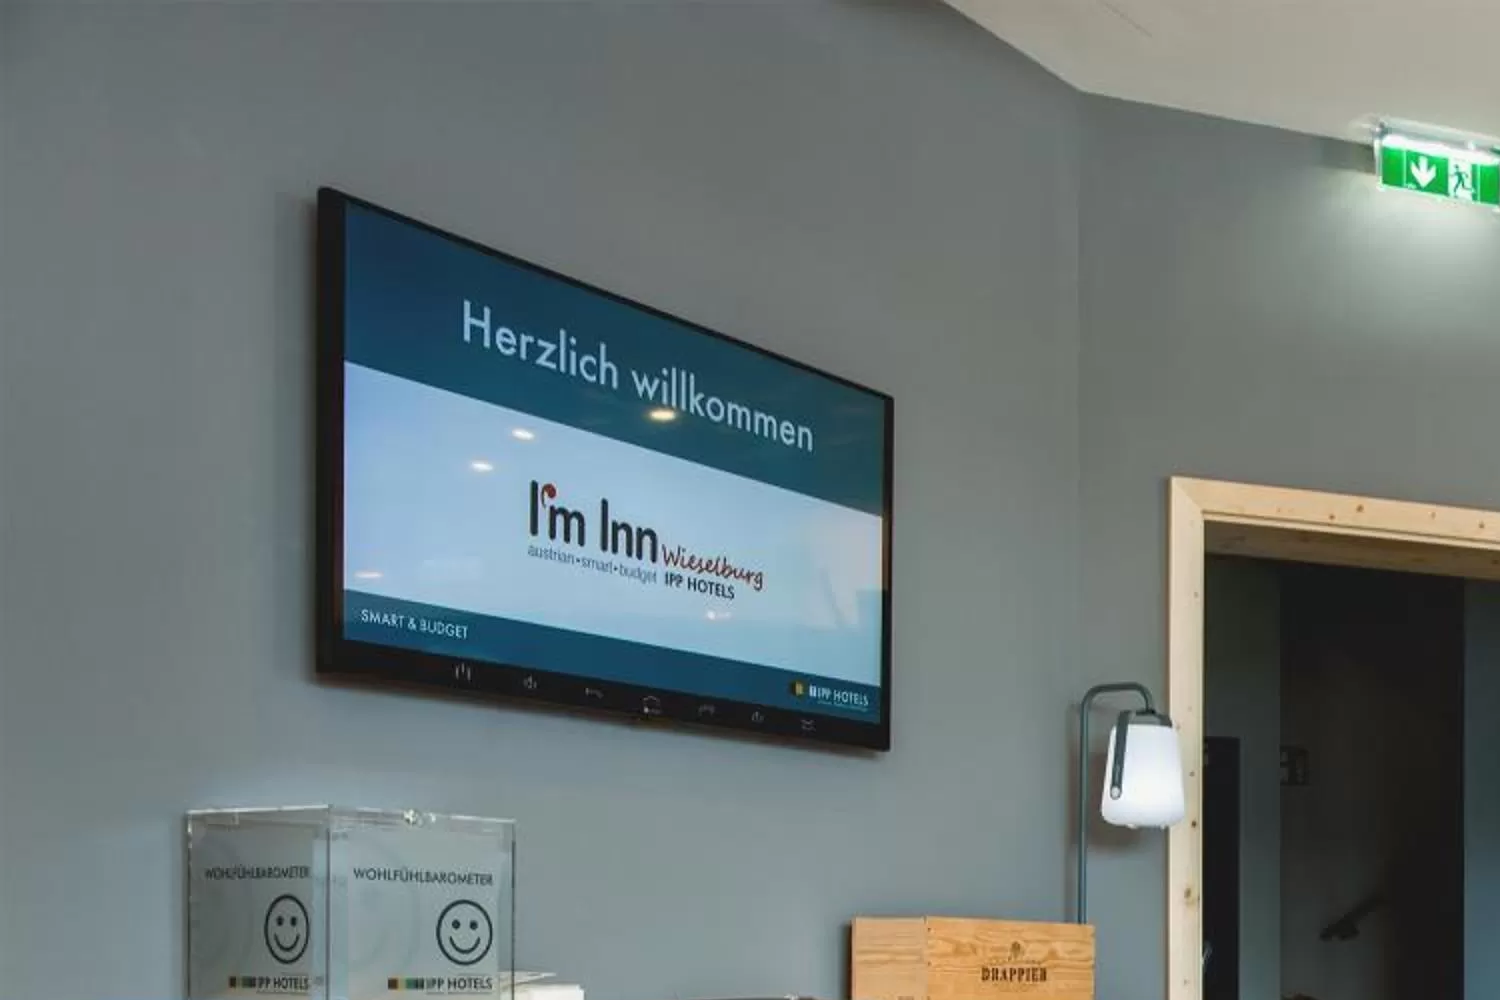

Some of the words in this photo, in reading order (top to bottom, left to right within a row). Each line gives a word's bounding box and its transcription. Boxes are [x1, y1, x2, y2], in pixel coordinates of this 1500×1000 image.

[463, 299, 618, 389] Herzlich
[631, 365, 814, 452] willkommen
[529, 480, 586, 547] I'm
[600, 498, 658, 564] Inn
[661, 544, 764, 592] Wieselburg
[687, 575, 735, 600] HOTELS
[361, 608, 405, 629] SMART
[407, 618, 417, 631] &
[419, 619, 469, 639] BUDGET
[833, 689, 869, 706] HOTELS
[353, 866, 494, 886] WOHLFÜHLBAROMETER
[273, 976, 310, 991] HOTELS
[447, 977, 493, 991] HOTELS
[981, 967, 1047, 982] DRAPPIER
